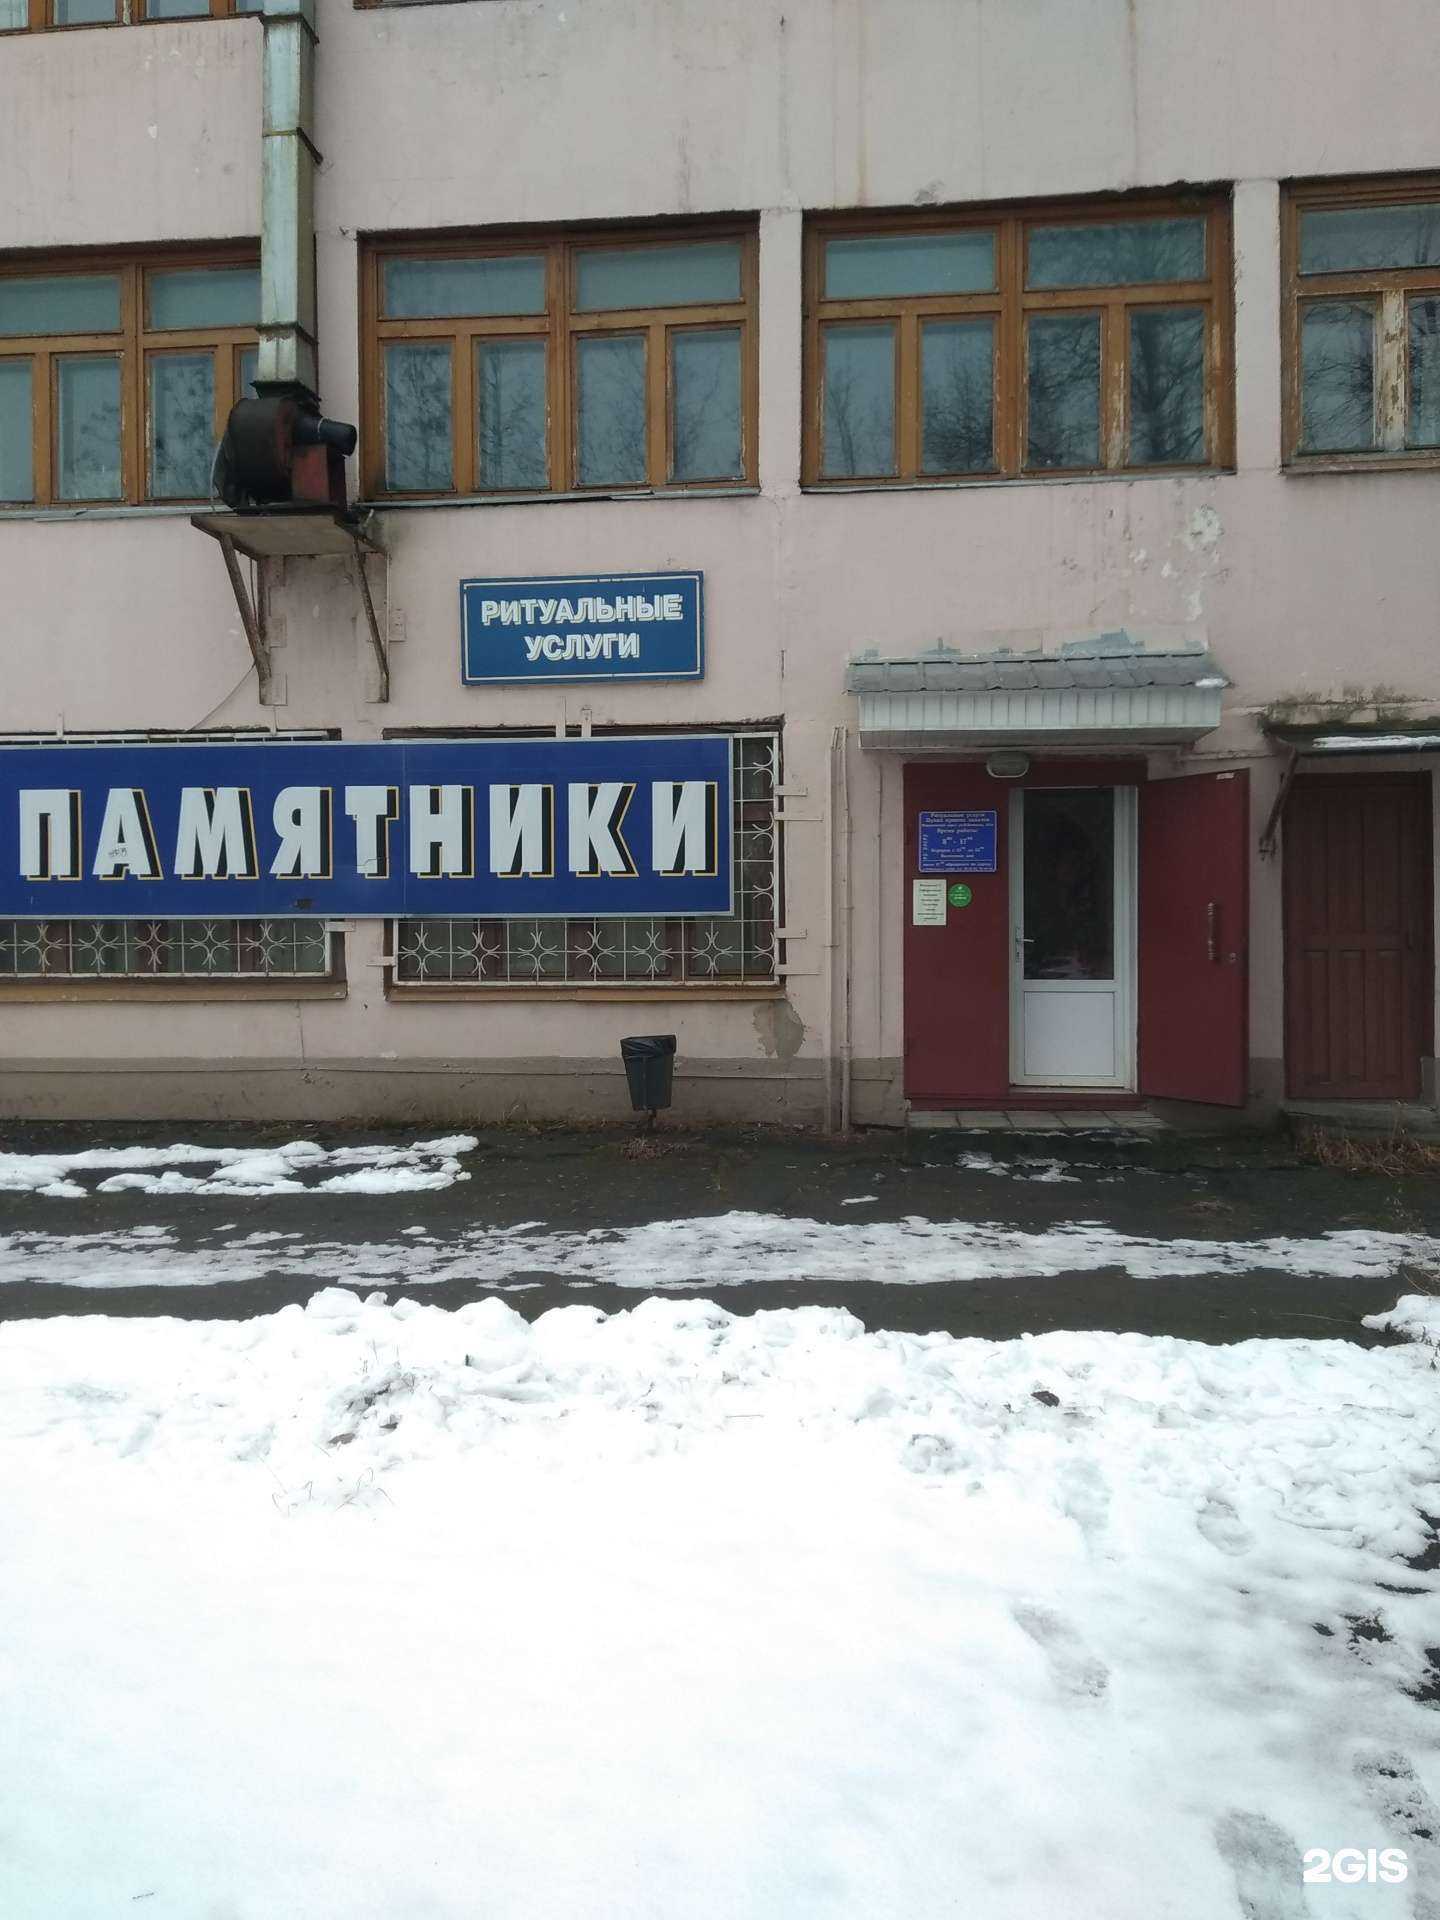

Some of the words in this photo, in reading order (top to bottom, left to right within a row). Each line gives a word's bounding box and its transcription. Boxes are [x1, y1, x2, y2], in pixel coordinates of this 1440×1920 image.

[481, 593, 684, 626] РИТУАЛЬНЫЕ
[524, 632, 640, 661] УСЛУГИ
[19, 781, 719, 881] ПАМЯТНИКИ
